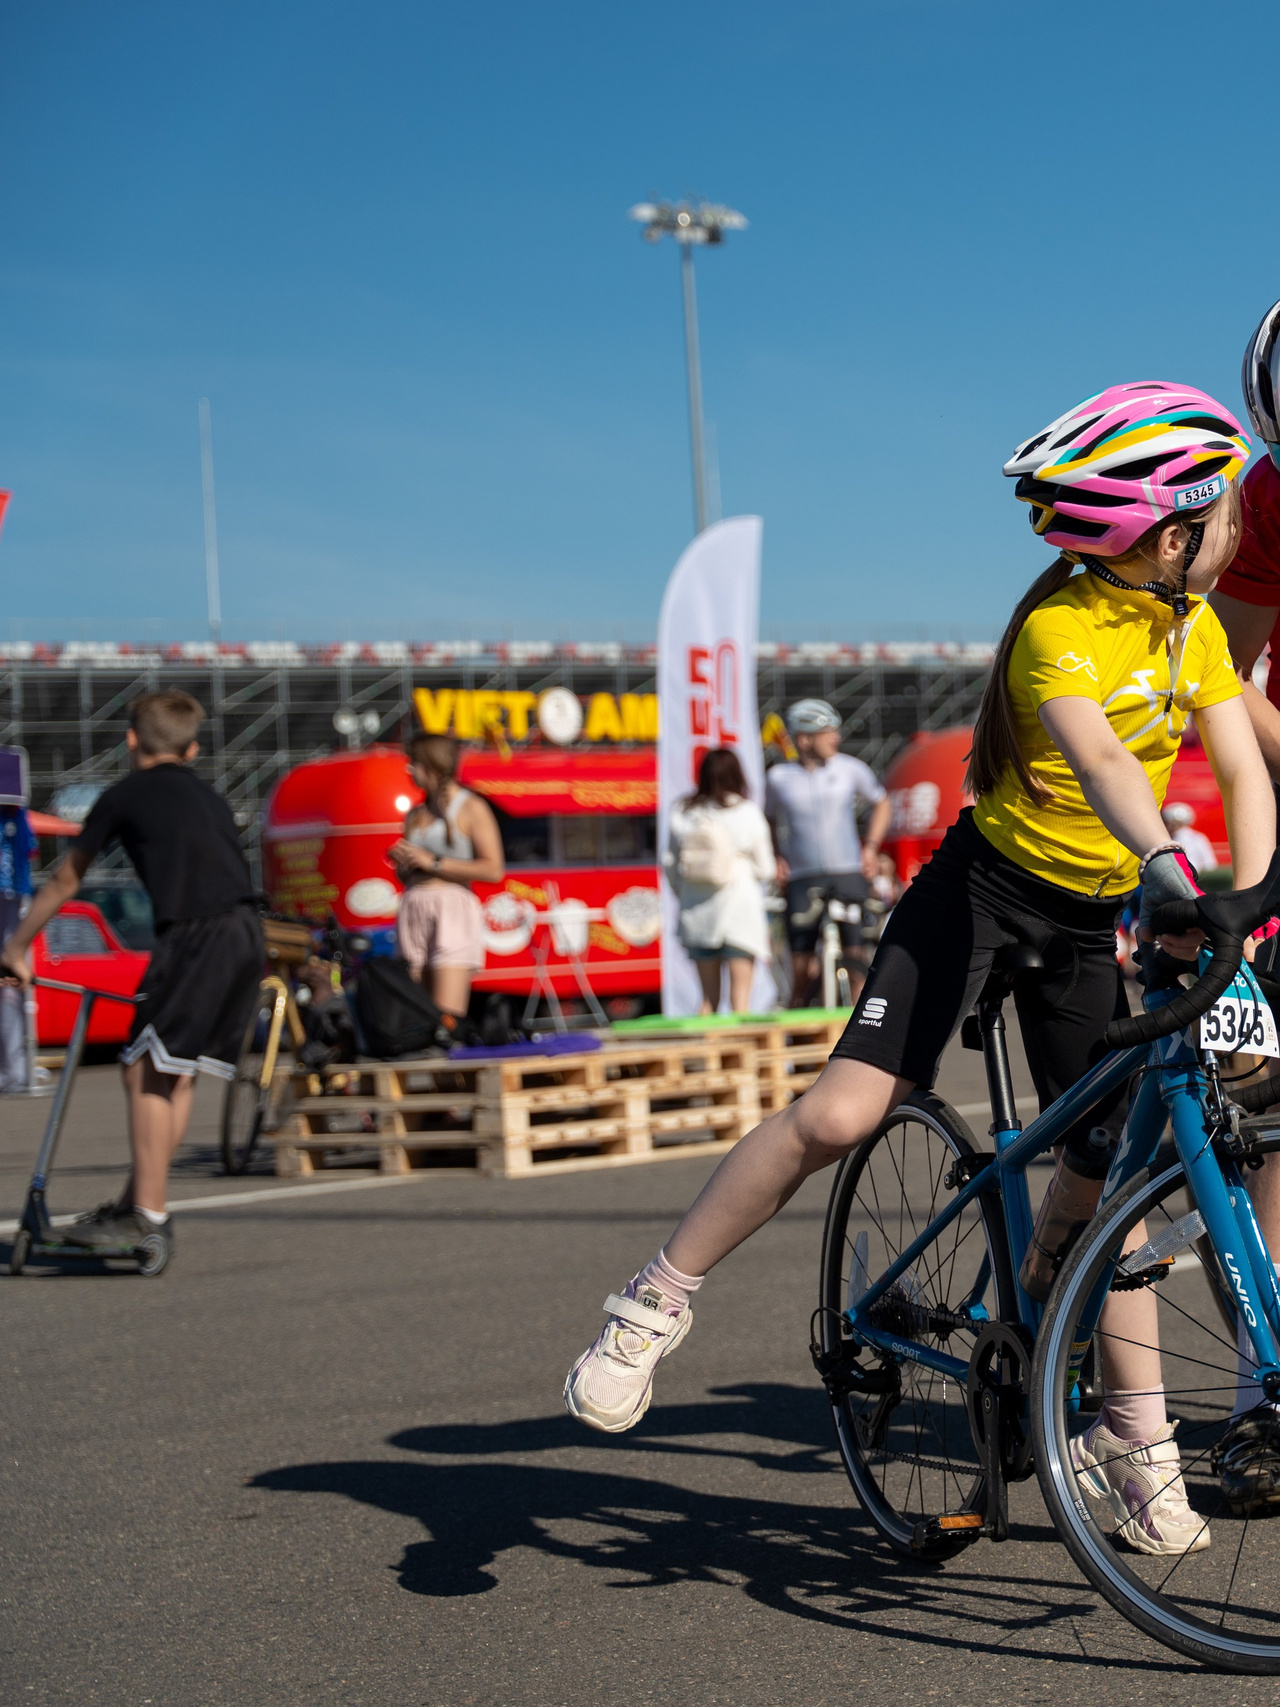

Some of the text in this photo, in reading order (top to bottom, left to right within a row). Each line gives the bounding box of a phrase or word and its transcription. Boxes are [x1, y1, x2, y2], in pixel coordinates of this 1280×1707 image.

[1185, 483, 1214, 503] 5345
[858, 1019, 882, 1028] sportful
[1206, 1003, 1265, 1047] 5345
[1224, 1252, 1257, 1328] UNIQ
[891, 1342, 921, 1360] SPORT
